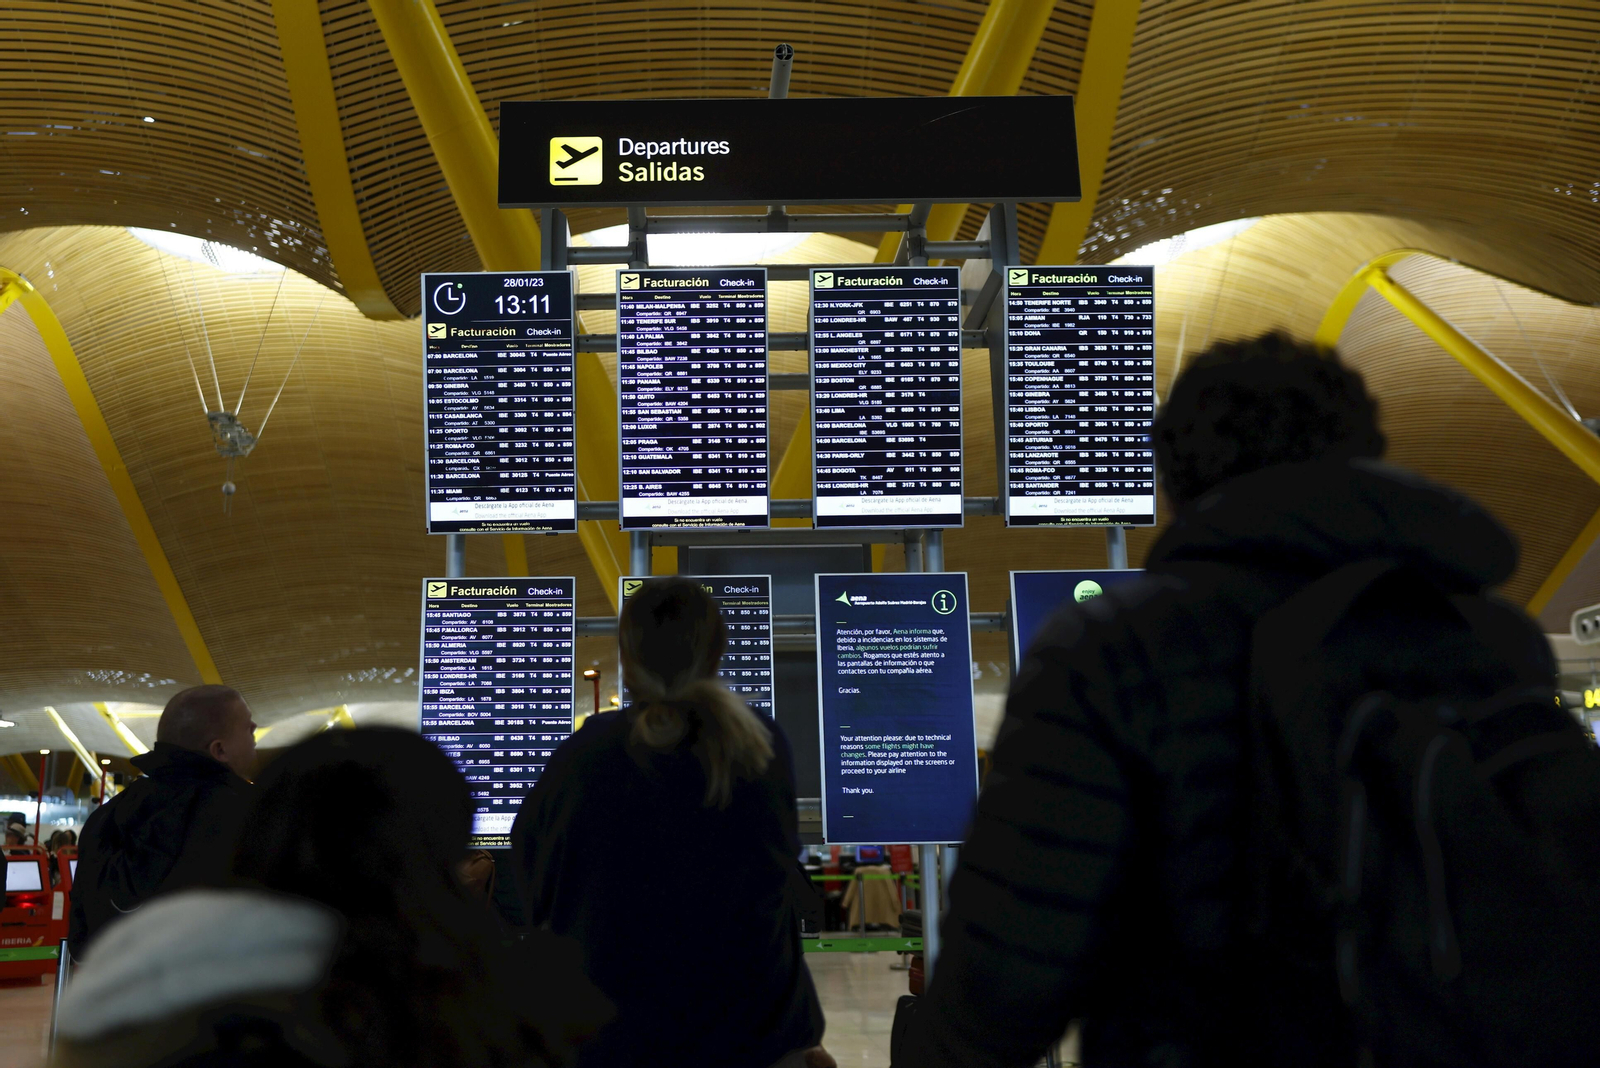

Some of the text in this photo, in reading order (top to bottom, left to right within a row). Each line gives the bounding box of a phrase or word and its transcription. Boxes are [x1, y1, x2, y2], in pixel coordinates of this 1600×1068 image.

[619, 138, 730, 159] Departures
[618, 162, 704, 182] Salidas
[504, 278, 544, 287] 28/01/23
[644, 278, 709, 288] Facturación
[838, 276, 902, 286] Facturación
[1032, 274, 1097, 283] Facturación
[494, 295, 550, 314] 13:11
[451, 327, 561, 336] Facturación Check-in
[451, 586, 517, 596] Facturación
[724, 585, 759, 594] Check-in
